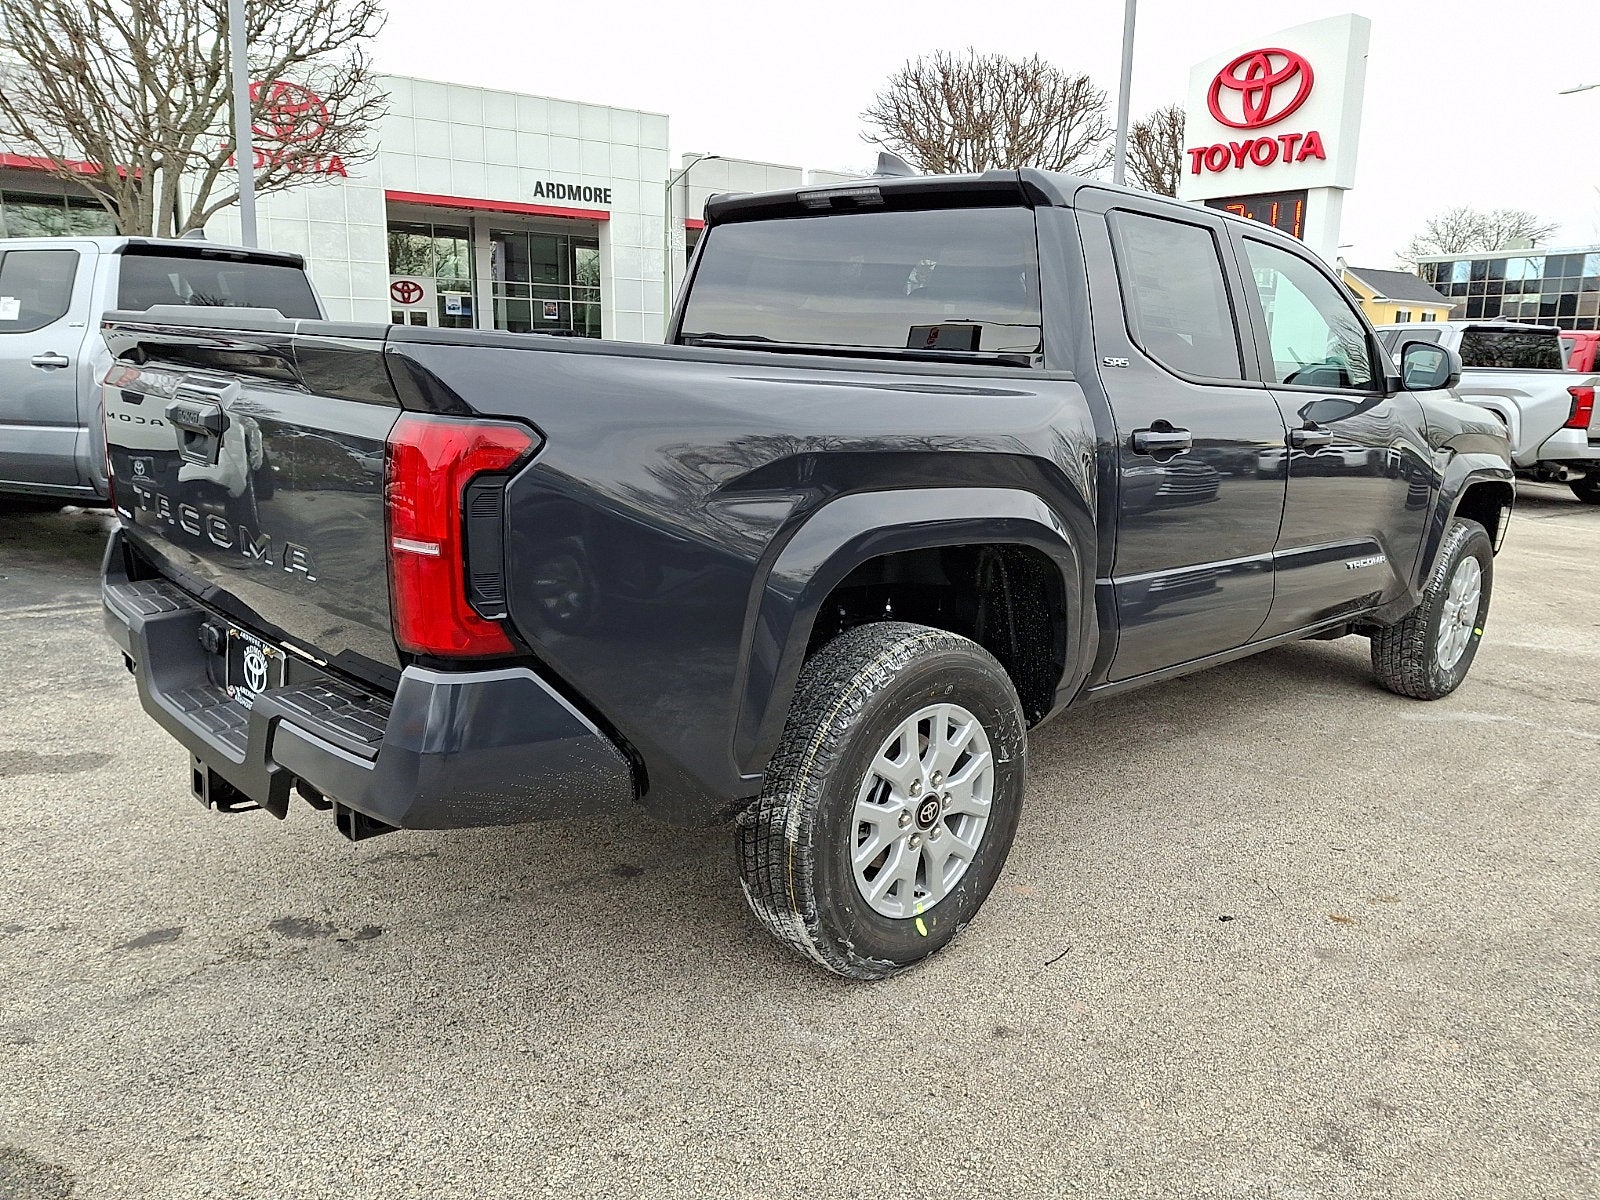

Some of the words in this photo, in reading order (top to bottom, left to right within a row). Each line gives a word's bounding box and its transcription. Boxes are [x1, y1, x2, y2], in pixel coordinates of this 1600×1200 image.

[1187, 131, 1326, 174] TOYOTA
[534, 181, 611, 204] ARDMORE
[1103, 356, 1129, 368] SR5
[133, 484, 317, 581] TACOMA
